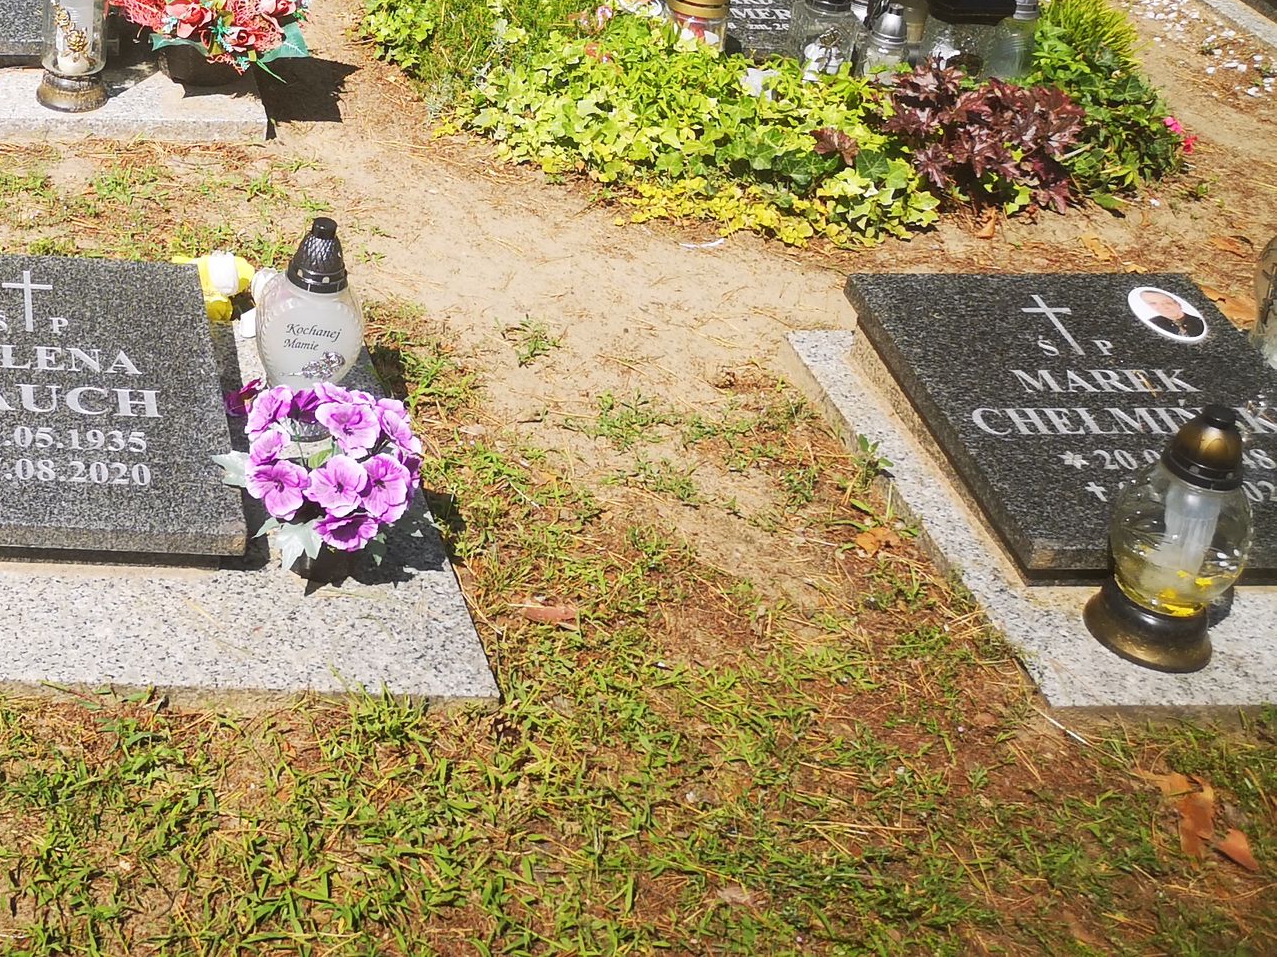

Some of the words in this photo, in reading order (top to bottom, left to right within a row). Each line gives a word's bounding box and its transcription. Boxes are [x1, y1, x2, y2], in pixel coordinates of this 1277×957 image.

[50, 317, 69, 334] P
[286, 323, 342, 343] Kochanej
[283, 338, 320, 351] Mamie
[1092, 339, 1114, 356] P
[1011, 369, 1203, 393] MAREK
